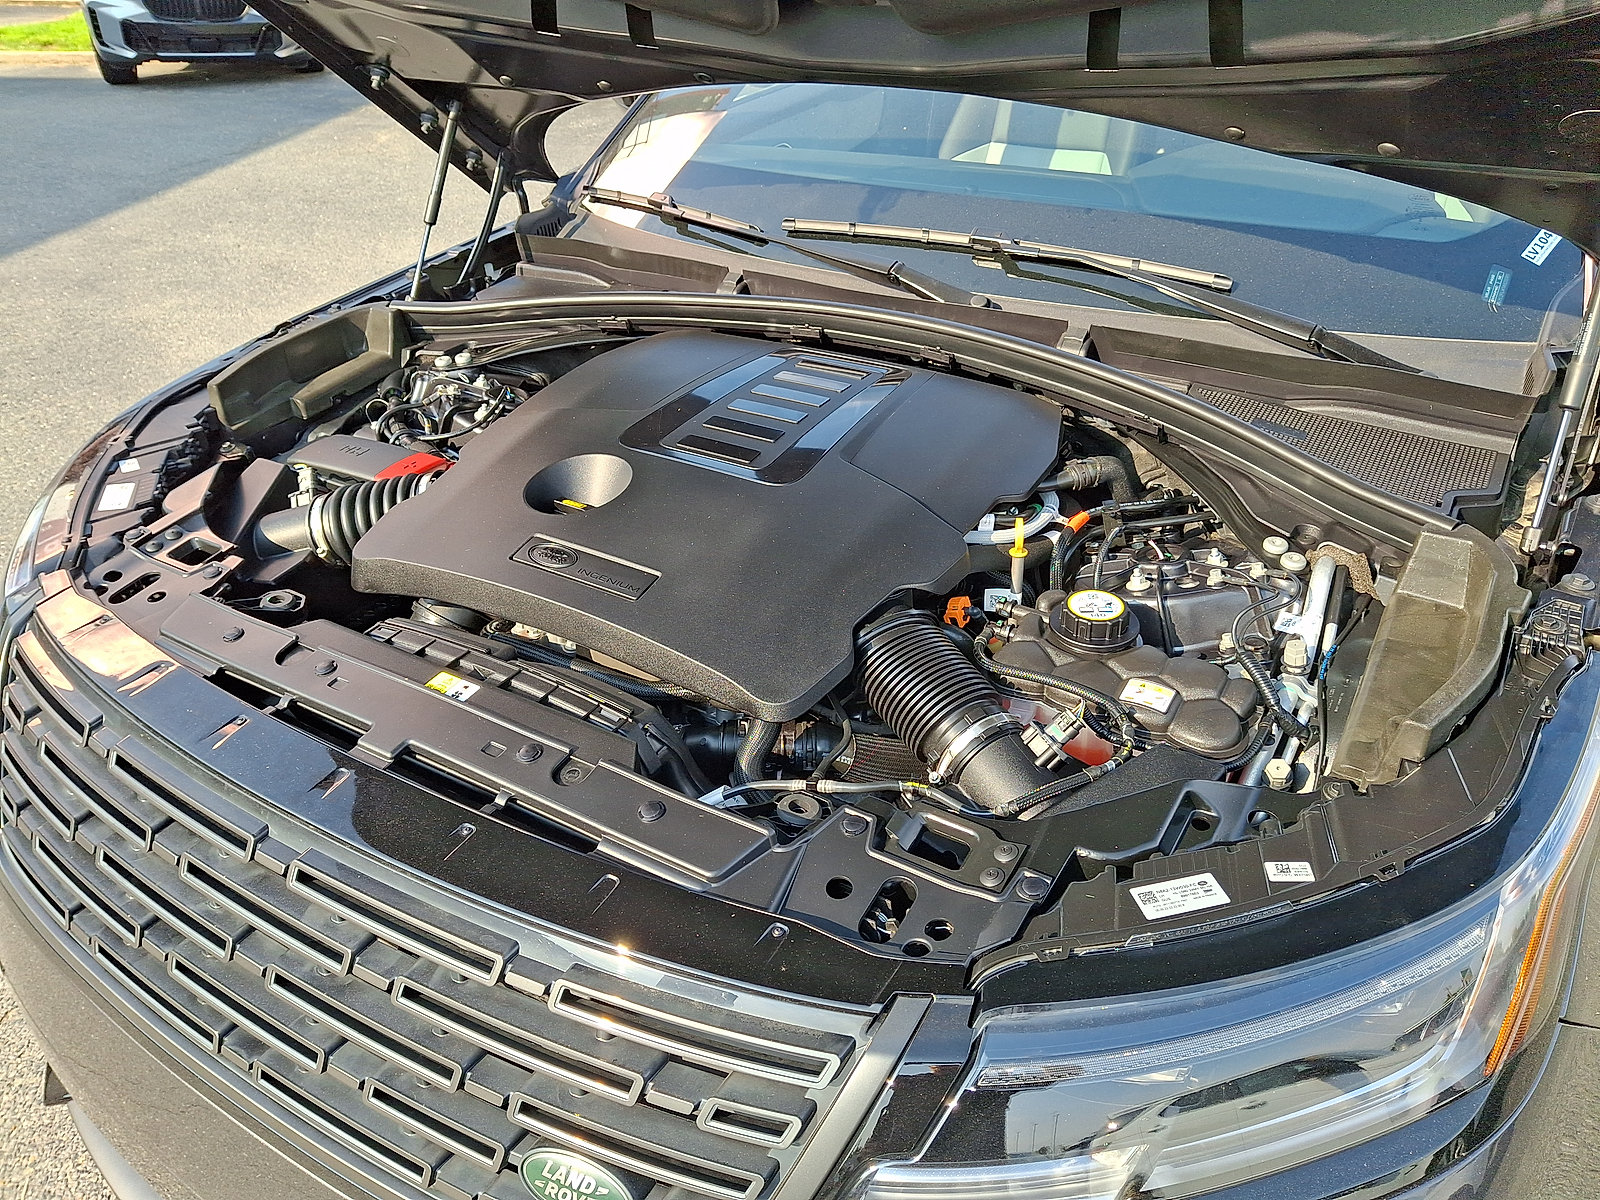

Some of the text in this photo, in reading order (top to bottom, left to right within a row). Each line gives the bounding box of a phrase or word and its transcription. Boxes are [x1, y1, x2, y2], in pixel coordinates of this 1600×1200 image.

[1525, 231, 1554, 261] LV104
[577, 568, 640, 592] INGENIUM
[541, 1160, 597, 1195] LAND
